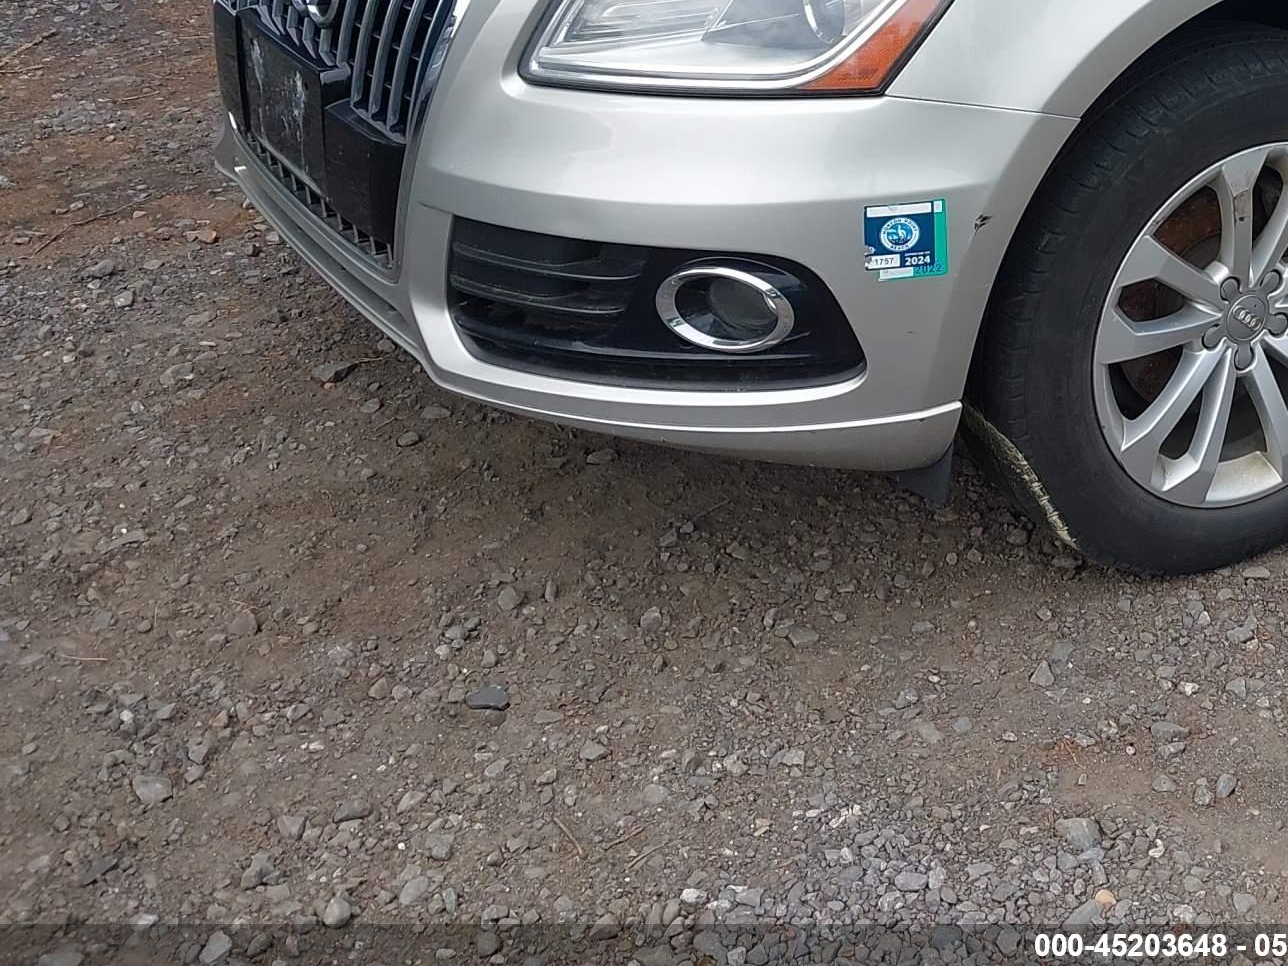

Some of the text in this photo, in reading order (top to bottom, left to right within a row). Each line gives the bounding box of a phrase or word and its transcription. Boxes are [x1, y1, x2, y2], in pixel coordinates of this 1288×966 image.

[874, 257, 895, 266] 1757
[904, 255, 931, 266] 2024
[915, 263, 943, 275] 2022
